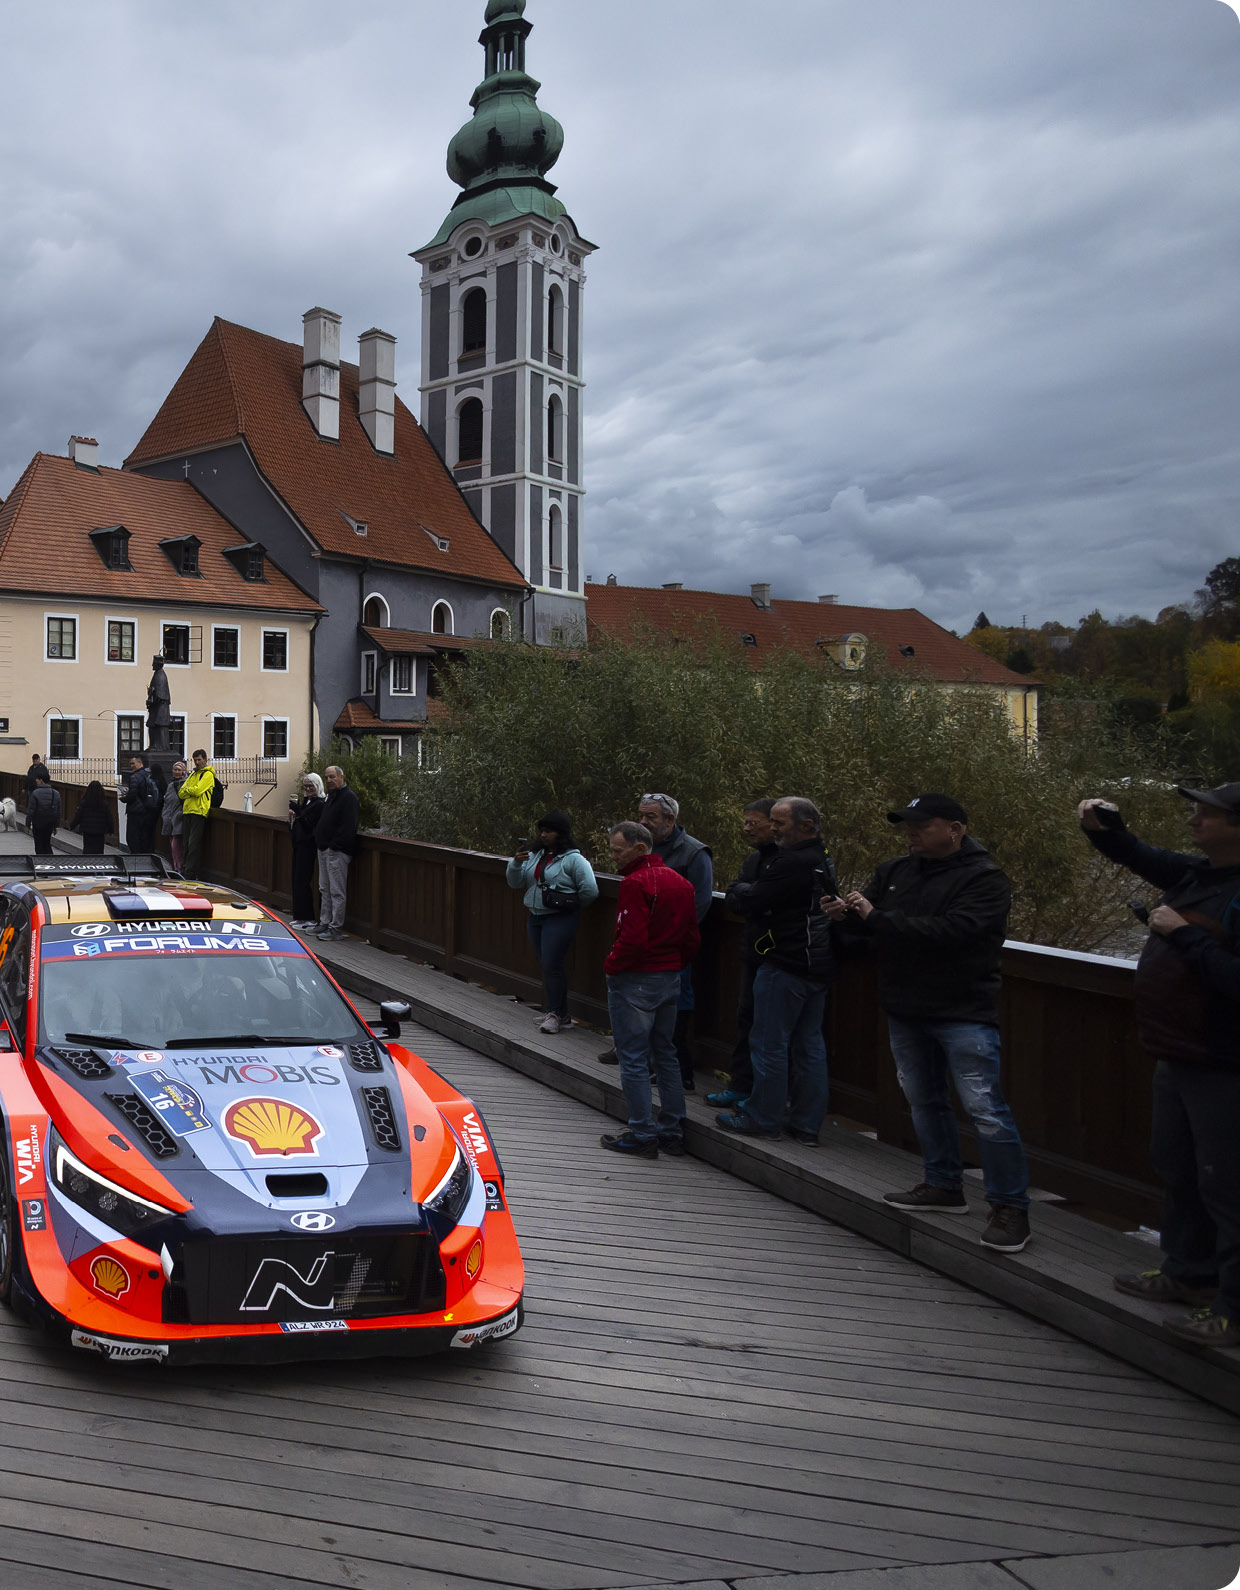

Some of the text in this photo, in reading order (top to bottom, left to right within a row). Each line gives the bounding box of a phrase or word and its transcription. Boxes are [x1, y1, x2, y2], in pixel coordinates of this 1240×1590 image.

[117, 921, 212, 933] HYUNDAI
[103, 936, 271, 952] FORUM8
[172, 1055, 269, 1066] HYUNDAI
[198, 1064, 341, 1086] MOBIS
[149, 1092, 175, 1110] 16
[29, 1124, 41, 1163] HYUNDAI
[460, 1130, 480, 1170] HYUNDAI
[288, 1320, 346, 1331] ALZ WR 924
